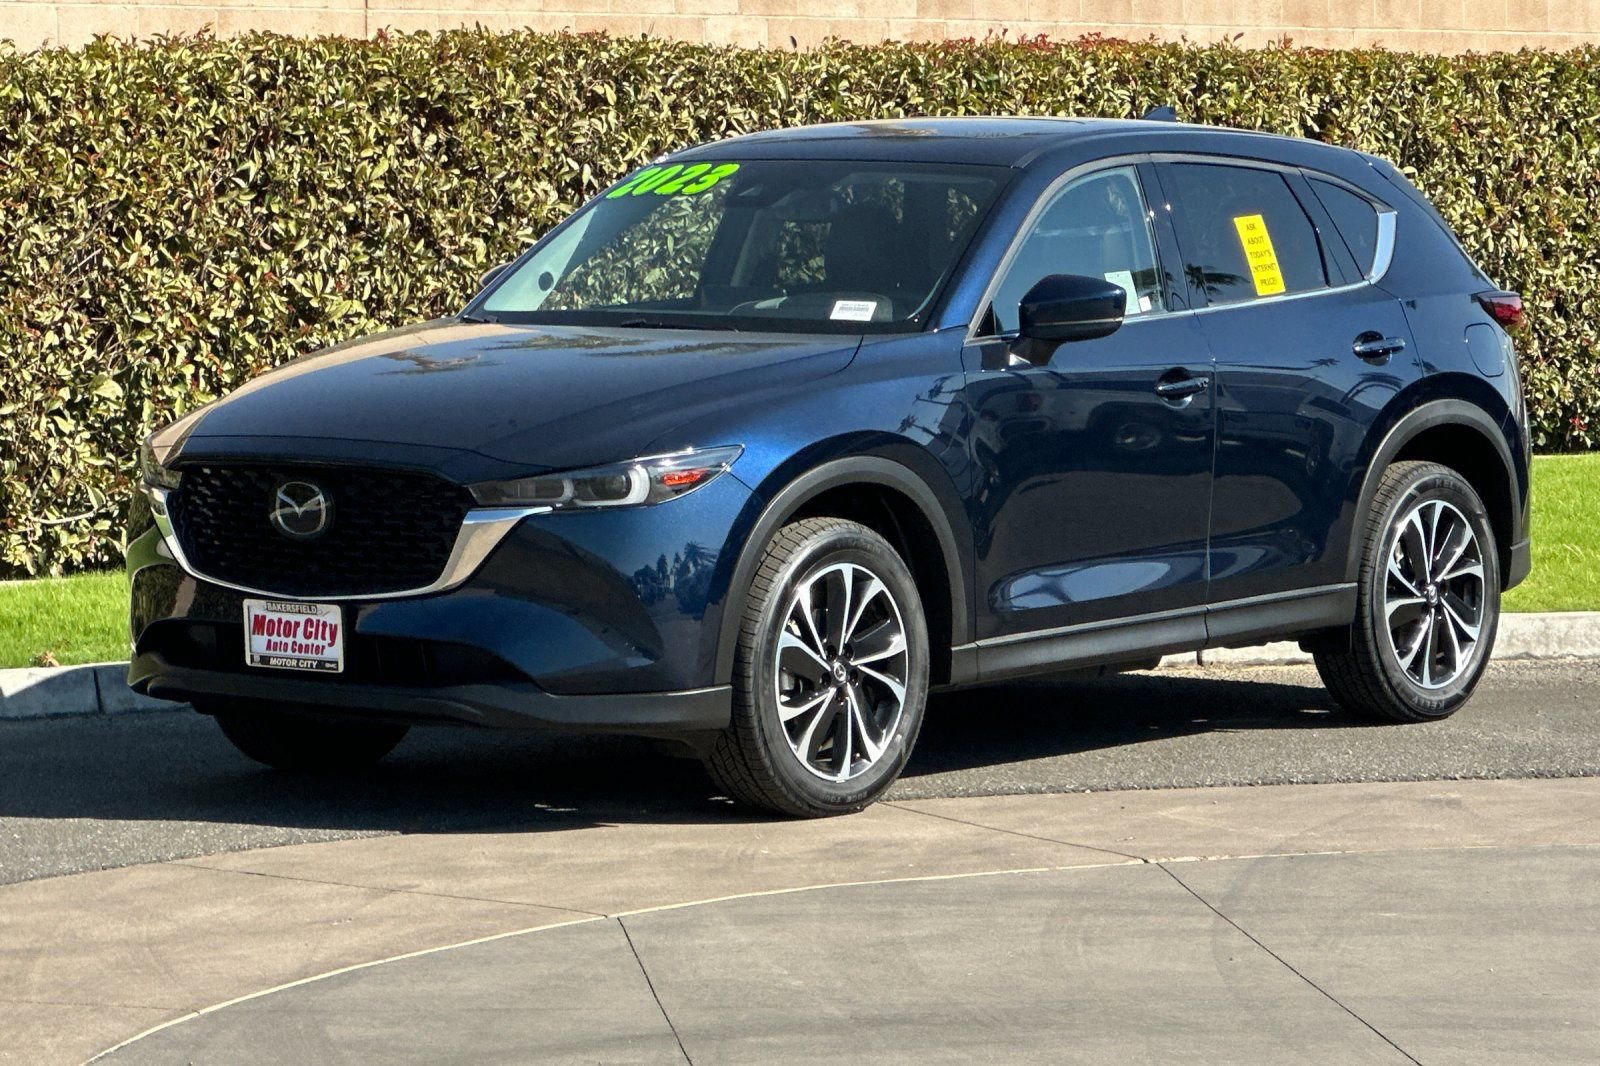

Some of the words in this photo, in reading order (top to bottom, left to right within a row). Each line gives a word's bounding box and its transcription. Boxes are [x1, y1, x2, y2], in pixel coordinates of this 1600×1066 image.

[605, 163, 740, 199] 2023
[1246, 223, 1256, 231] ASK
[1247, 236, 1264, 245] ABOUT
[266, 602, 317, 614] BAKERSFIELD
[252, 614, 300, 638] Motor
[303, 617, 338, 647] City
[266, 638, 289, 652] Auto
[291, 640, 326, 656] Center
[269, 657, 298, 667] MOTOR
[299, 660, 318, 669] CITY
